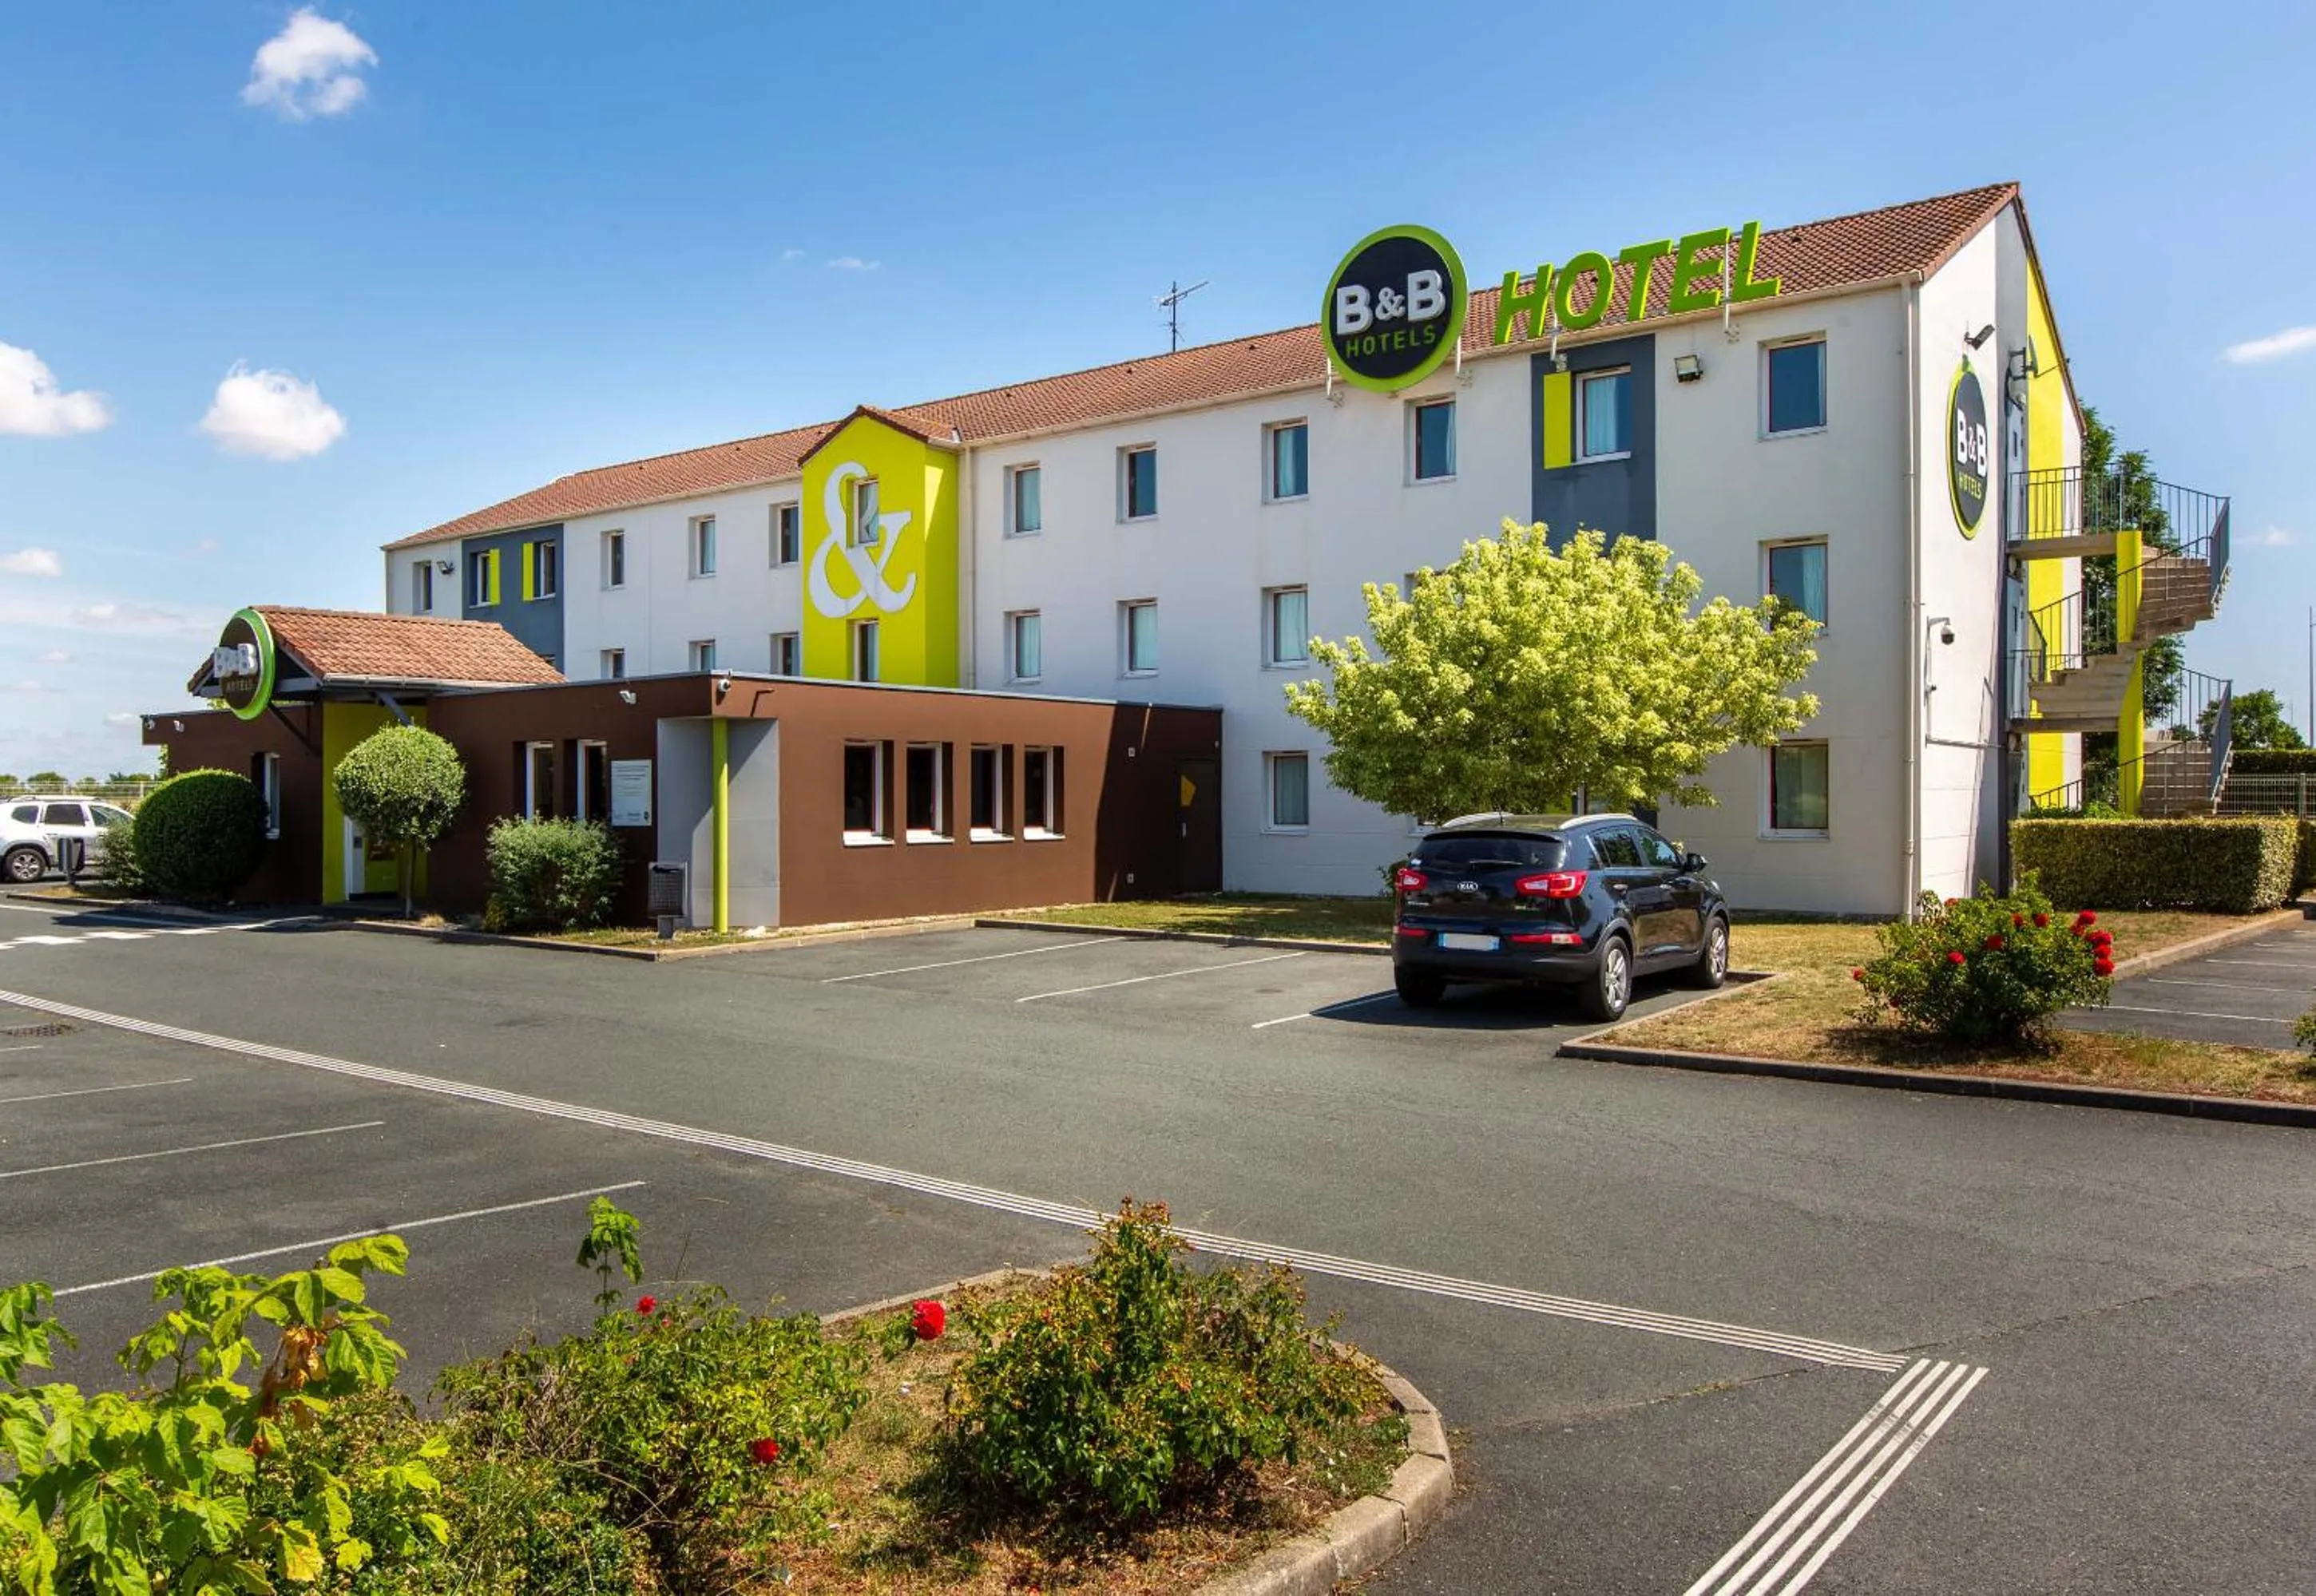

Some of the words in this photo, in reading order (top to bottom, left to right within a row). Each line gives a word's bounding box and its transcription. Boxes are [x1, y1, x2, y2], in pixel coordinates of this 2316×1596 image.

[1336, 270, 1446, 335] B&B
[1495, 221, 1781, 345] HOTEL
[1346, 324, 1436, 358] HOTELS
[1957, 408, 1987, 477] B&B
[1458, 881, 1477, 891] KIA
